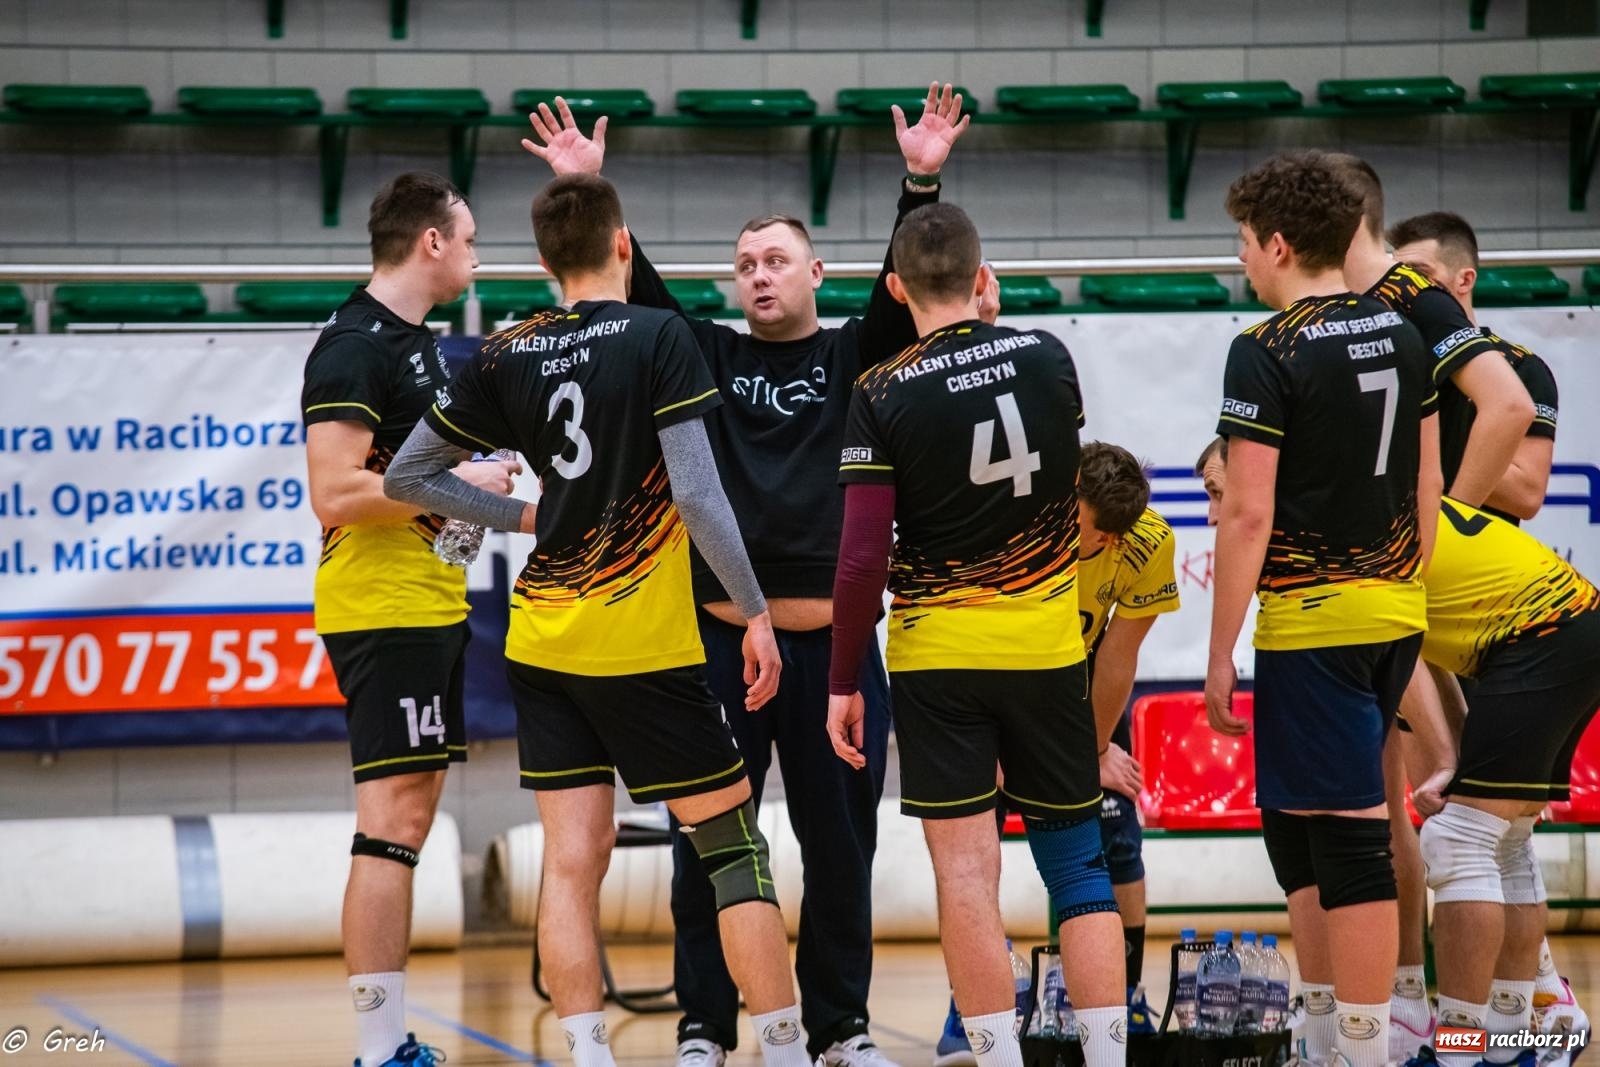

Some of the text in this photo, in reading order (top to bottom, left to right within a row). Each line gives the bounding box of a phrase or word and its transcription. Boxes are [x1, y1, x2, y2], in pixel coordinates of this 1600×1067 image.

[511, 336, 557, 353] TALENT
[1301, 320, 1349, 340] TALENT
[1347, 337, 1395, 360] CIESZYN
[895, 334, 1042, 383] TALENT SFERAWENT
[946, 361, 1017, 393] CIESZYN
[67, 426, 101, 451] w
[548, 381, 592, 480] 3
[1357, 367, 1400, 476] 7
[969, 392, 1041, 498] 4
[52, 478, 245, 523] Opawska
[257, 478, 303, 510] 69
[54, 532, 305, 573] Mickiewicza
[0, 632, 104, 700] 570
[117, 631, 192, 695] 77
[207, 629, 280, 693] 55
[400, 695, 446, 748] 14
